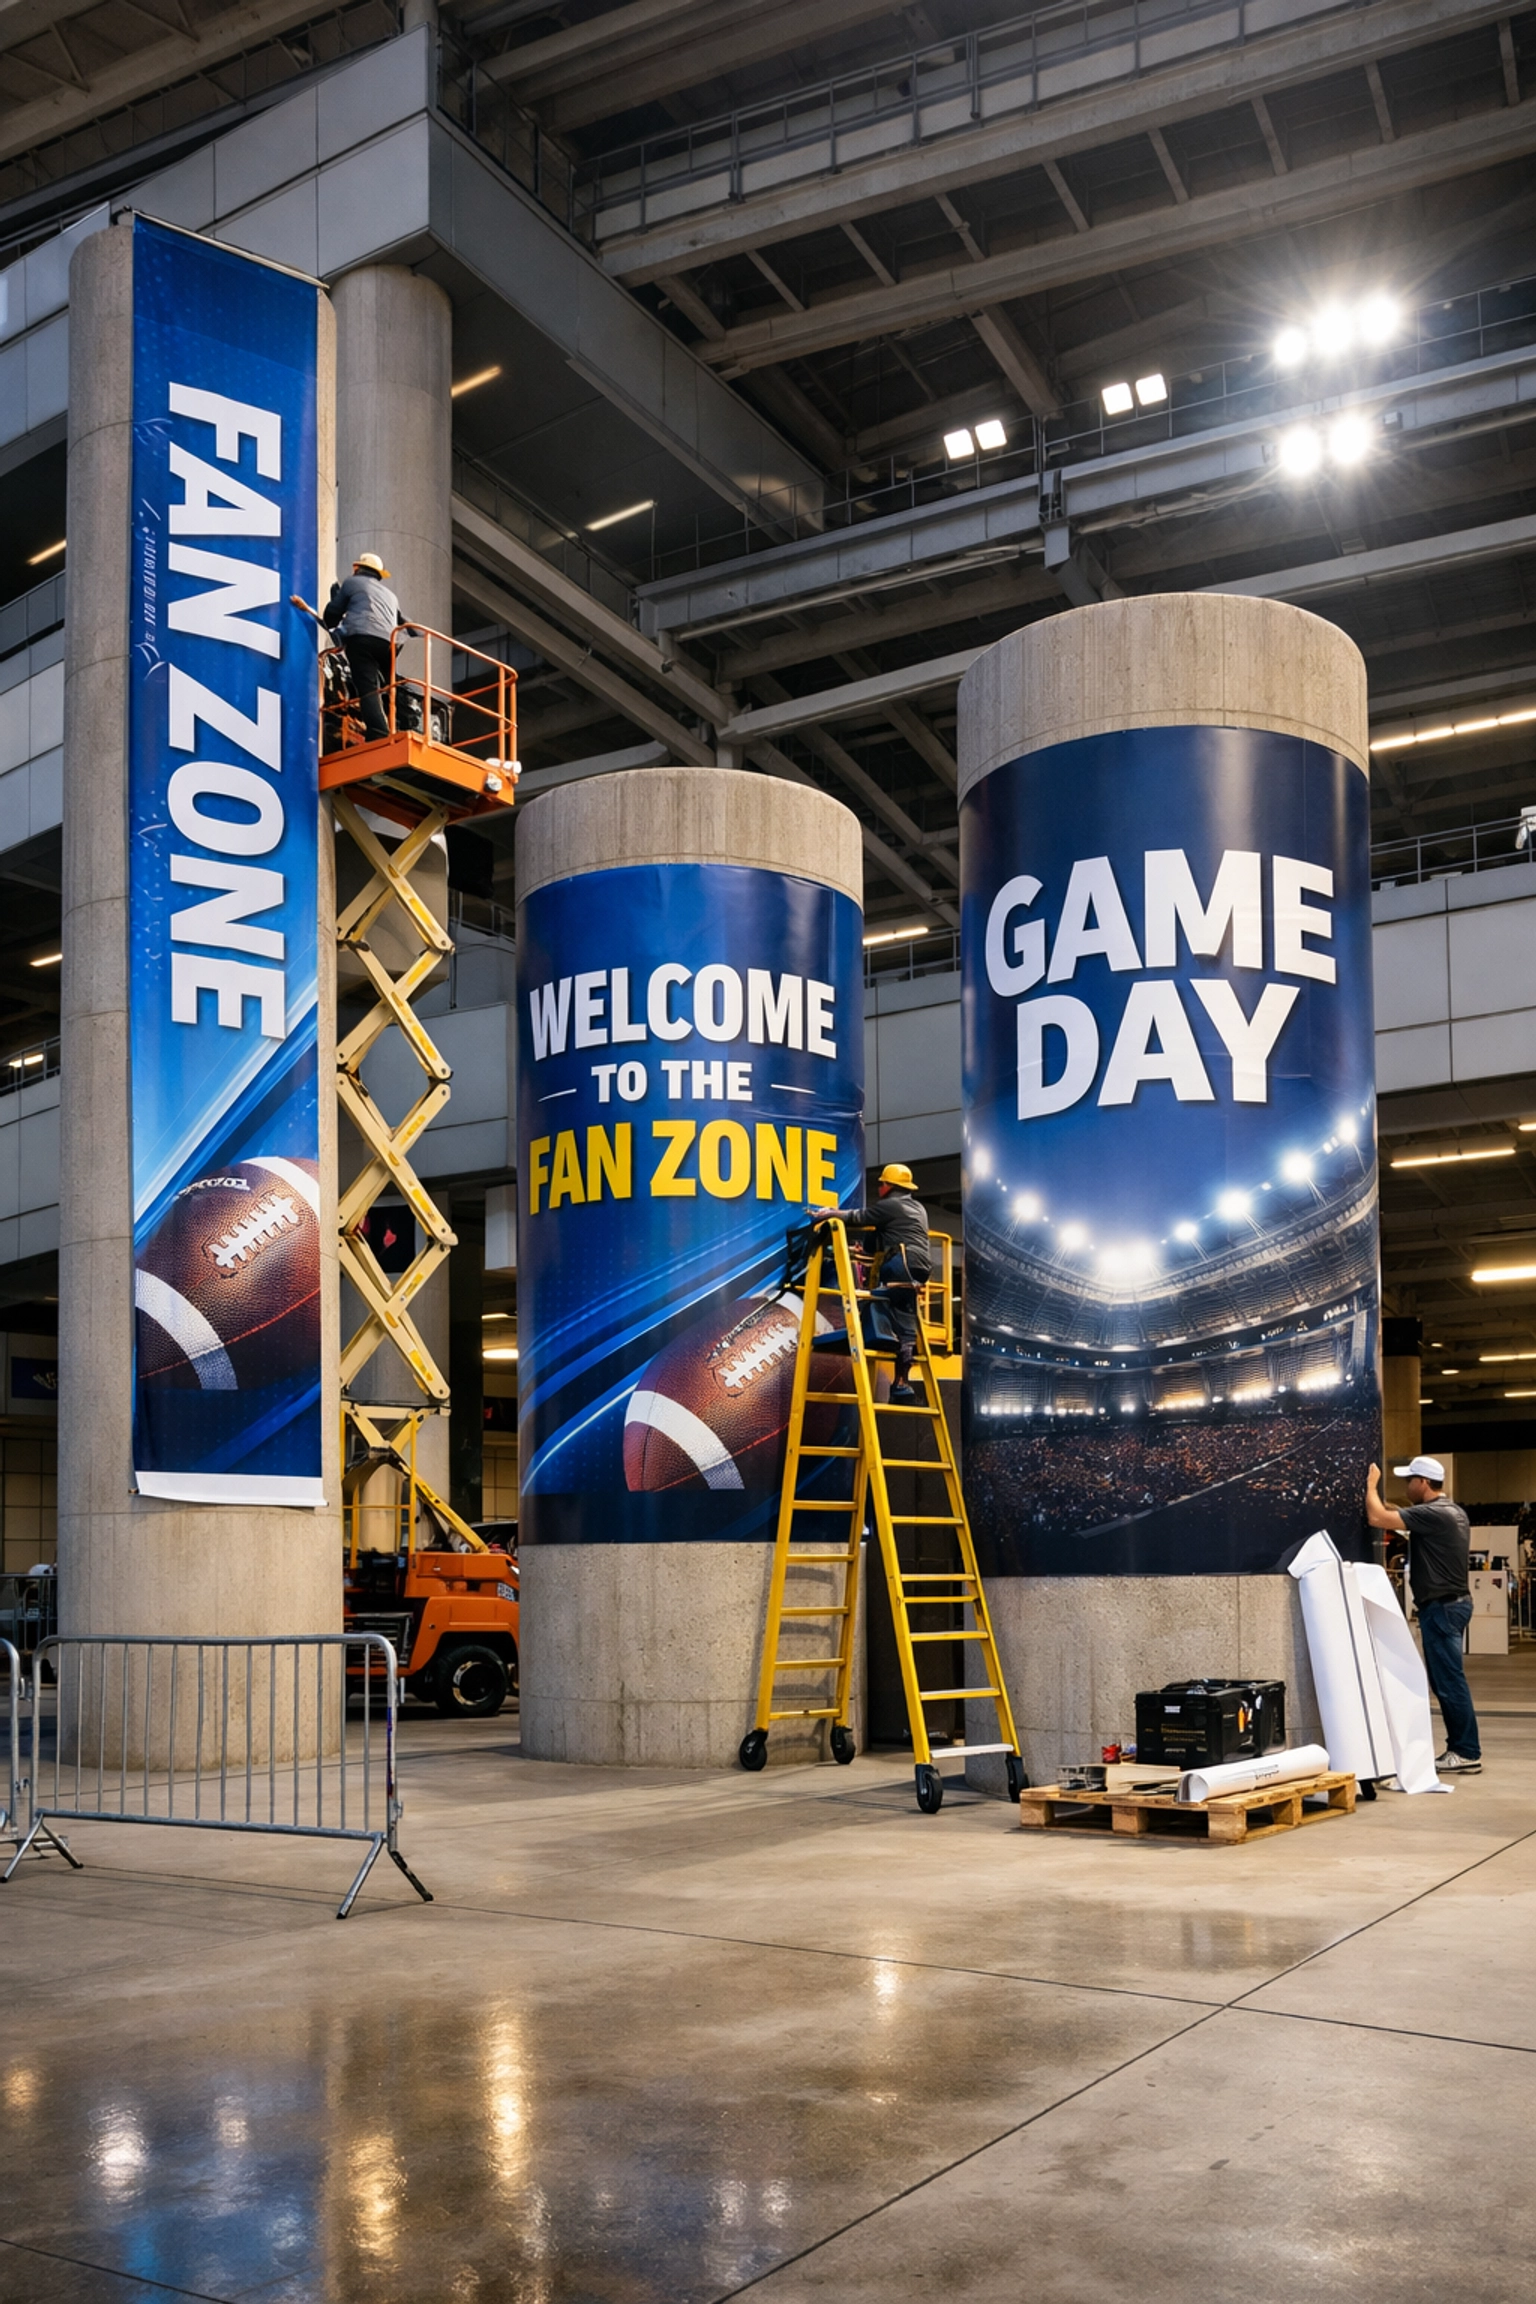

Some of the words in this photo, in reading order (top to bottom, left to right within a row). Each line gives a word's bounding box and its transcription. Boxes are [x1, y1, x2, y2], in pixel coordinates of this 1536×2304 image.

[168, 381, 281, 660] FAN
[168, 662, 286, 1040] ZONE
[985, 849, 1336, 997] GAME
[529, 963, 837, 1062] WELCOME
[591, 1061, 648, 1103] TO
[661, 1060, 753, 1101] THE
[1017, 979, 1300, 1120] DAY
[529, 1122, 632, 1216] FAN
[650, 1119, 839, 1208] ZONE
